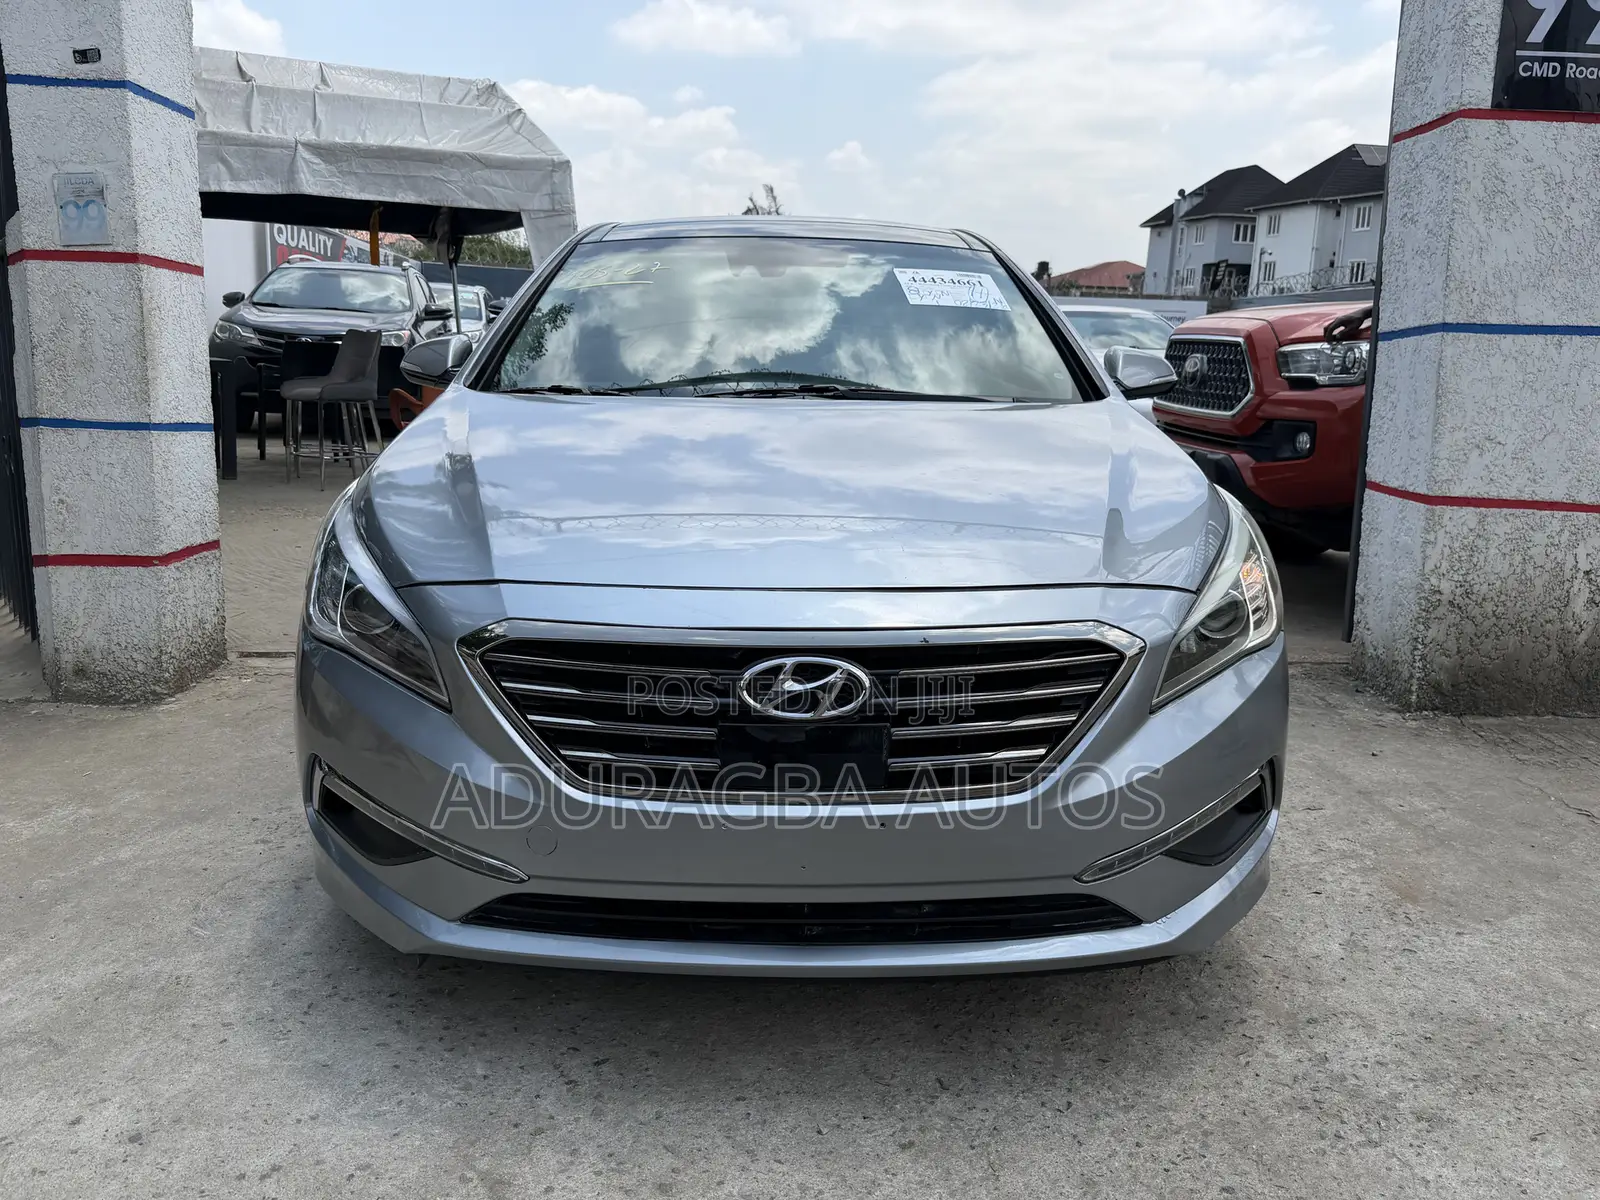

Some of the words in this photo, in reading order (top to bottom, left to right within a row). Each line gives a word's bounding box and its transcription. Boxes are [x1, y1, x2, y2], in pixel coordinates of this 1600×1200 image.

[1518, 61, 1561, 78] CMD
[1565, 62, 1600, 80] Roa
[62, 199, 107, 233] 99
[273, 223, 334, 257] QUALITY
[908, 275, 984, 288] 44434661
